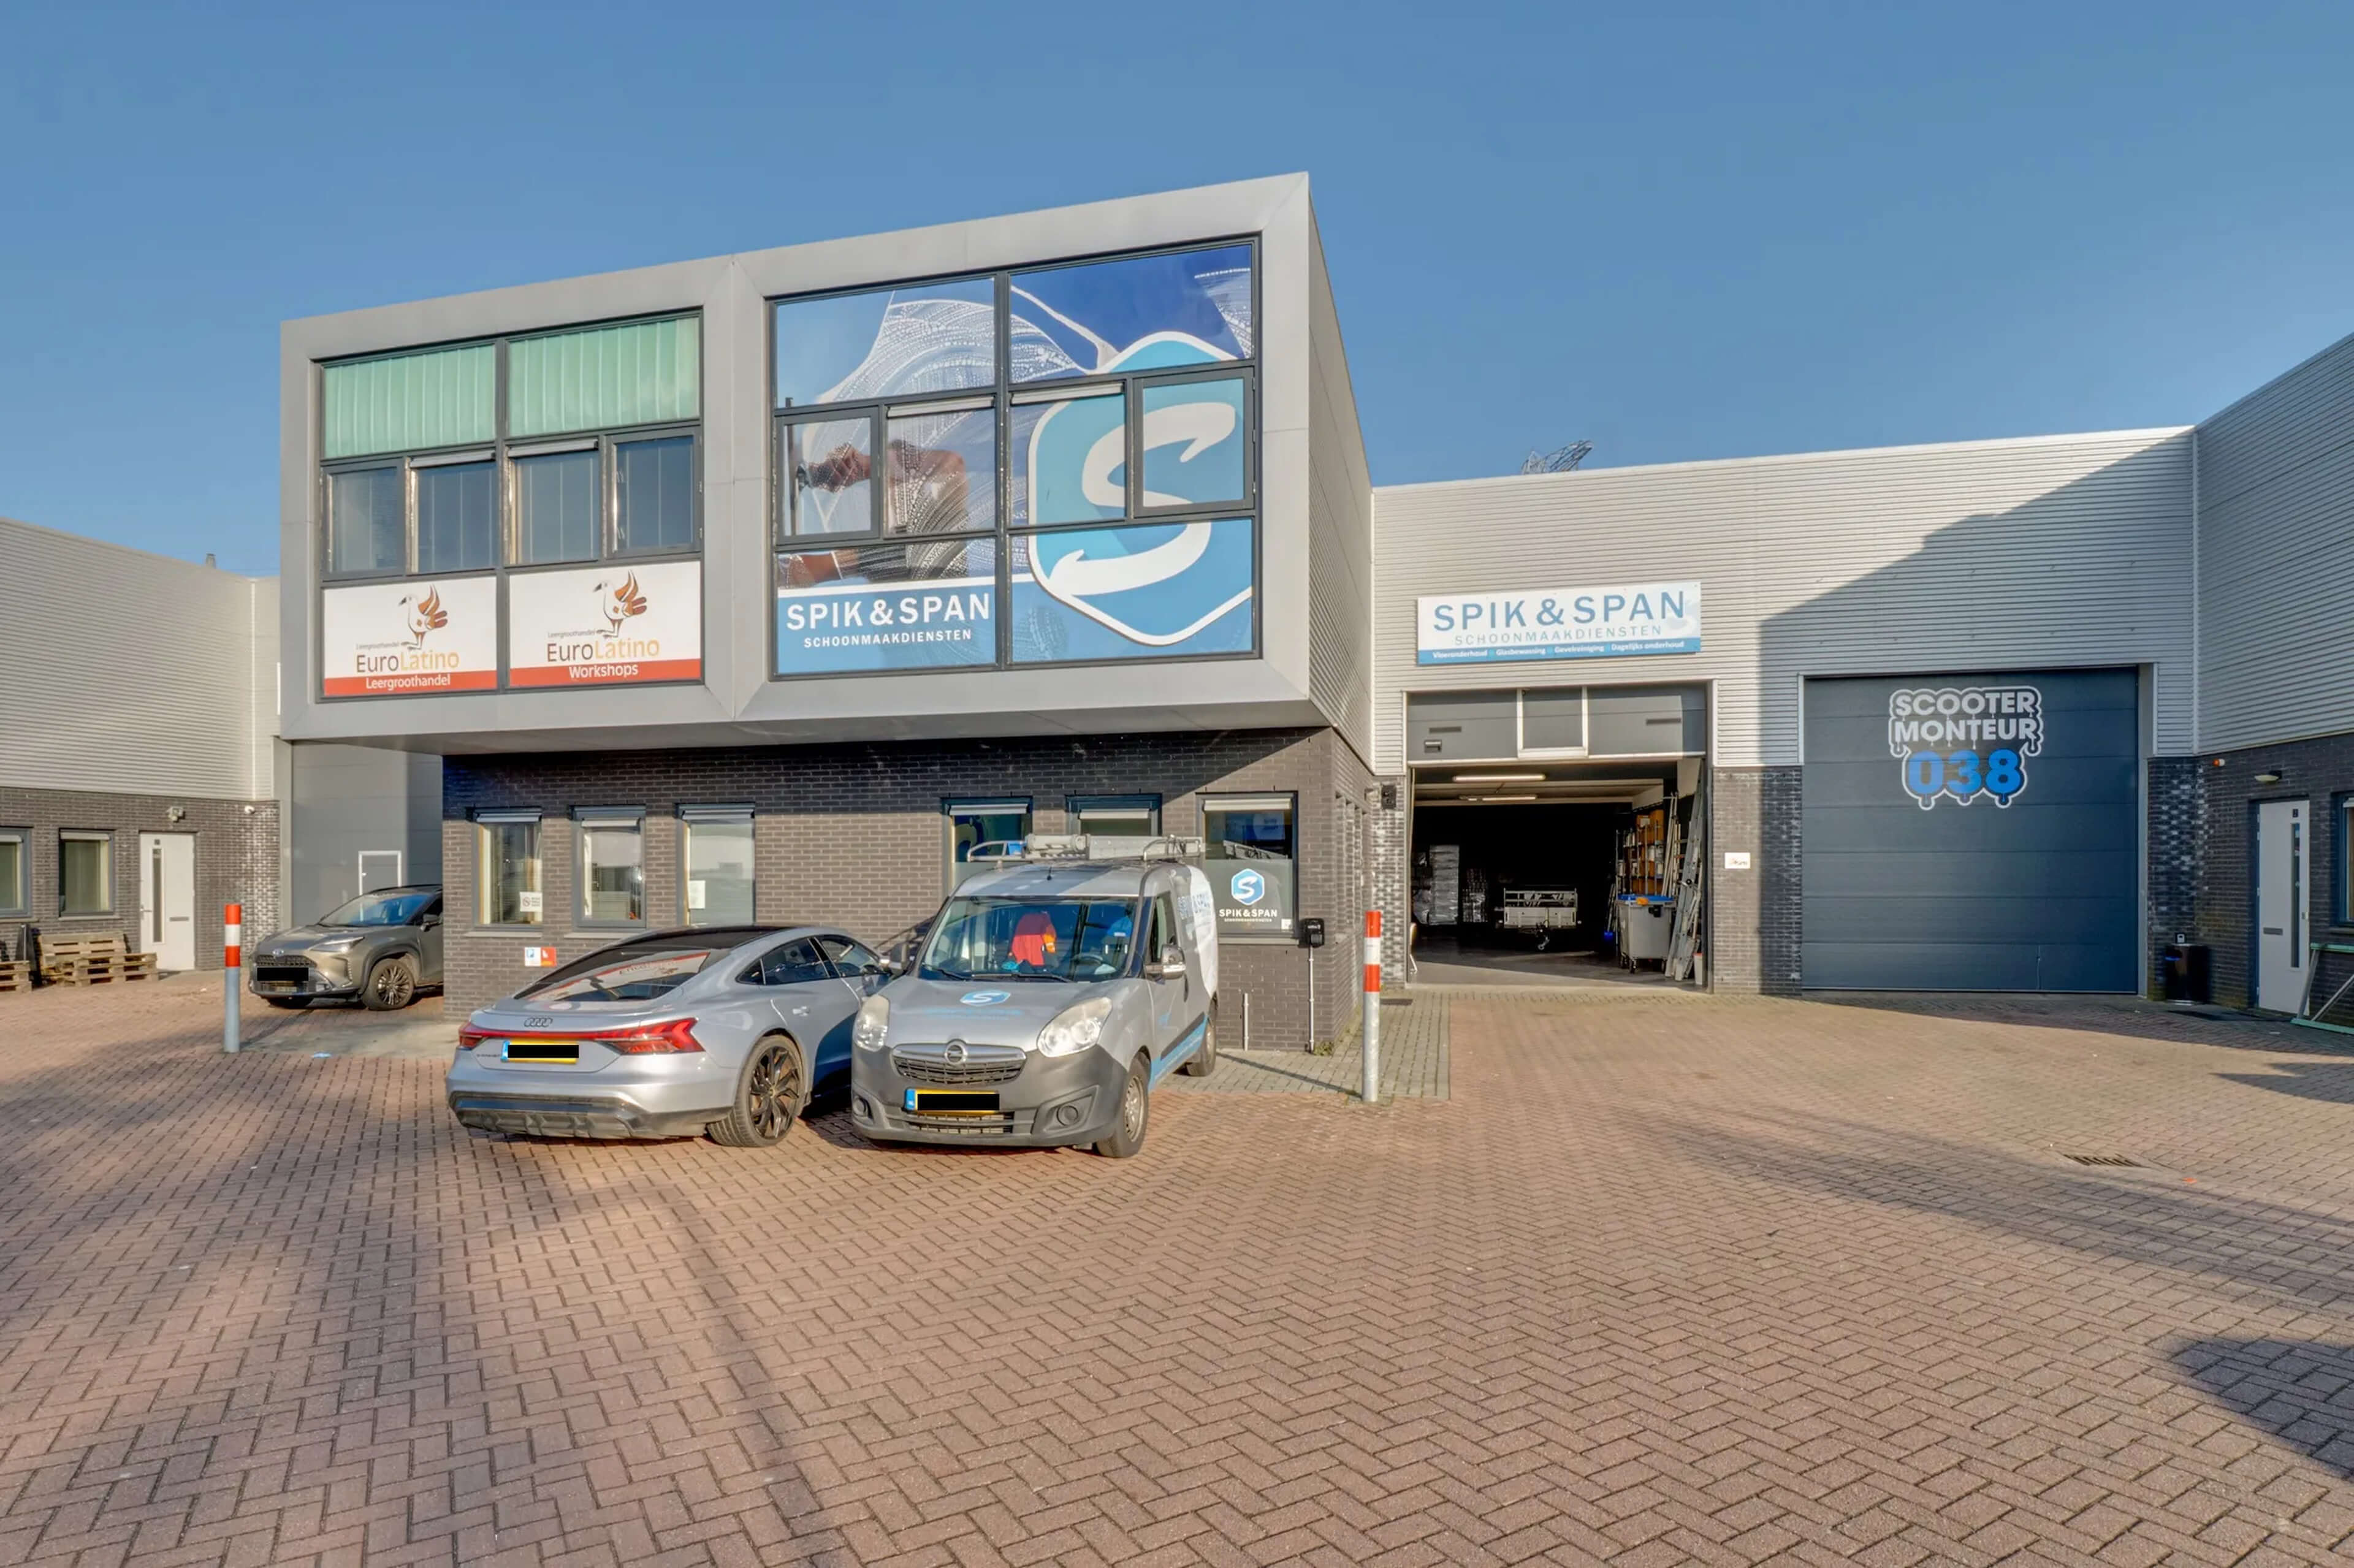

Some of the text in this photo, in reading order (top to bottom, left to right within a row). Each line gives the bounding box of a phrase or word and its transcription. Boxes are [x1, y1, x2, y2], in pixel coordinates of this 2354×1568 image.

[787, 593, 989, 631] SPIK & SPAN
[1433, 591, 1684, 631] SPIK & SPAN
[804, 629, 972, 648] SCHOONMAAKDIENSTEN
[1455, 625, 1662, 645] SCHOONMAAKDIENSTEN
[356, 649, 460, 673] EuroLatino
[547, 637, 660, 662] EuroLatino
[365, 673, 451, 690] Leergroothandel
[568, 663, 639, 679] Workshops
[1895, 691, 2036, 717] SCOOTER
[1894, 718, 2037, 743] MONTEUR
[1908, 748, 2021, 796] 038
[1219, 908, 1242, 917] SPIK
[1251, 908, 1278, 917] SPAN
